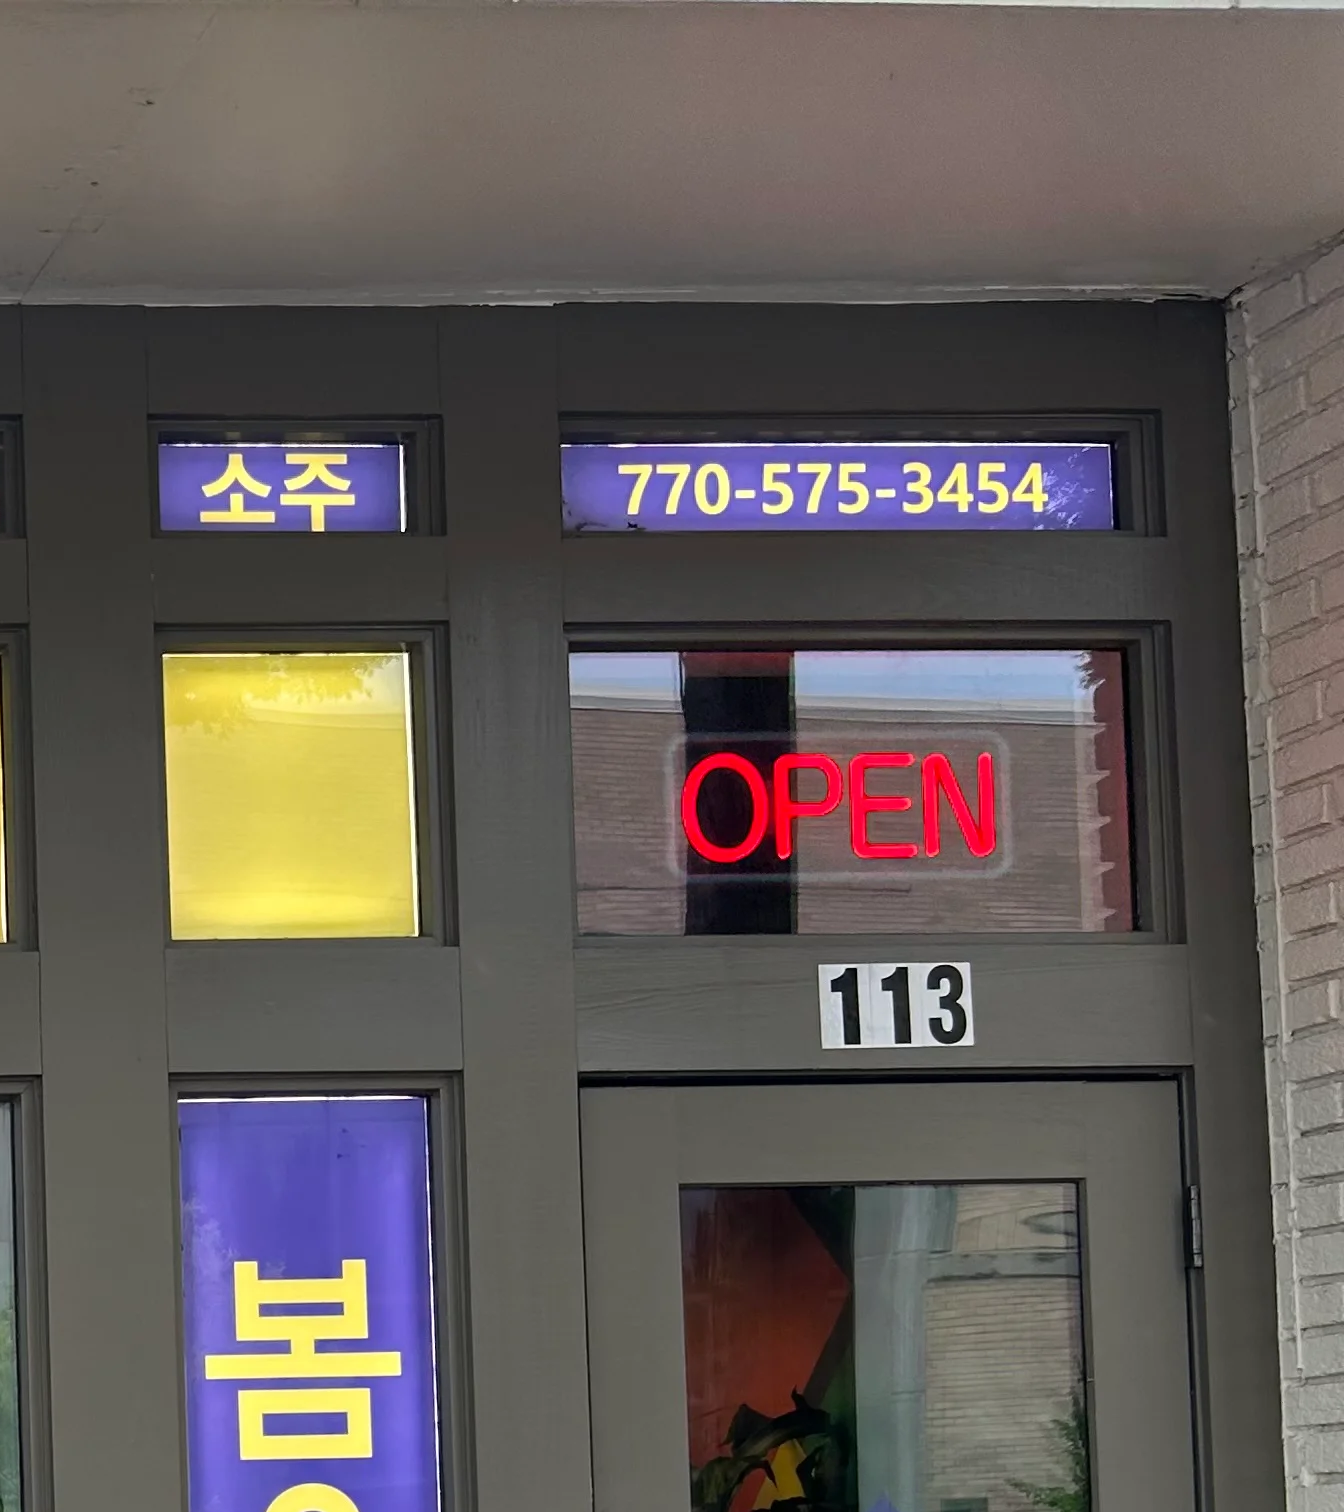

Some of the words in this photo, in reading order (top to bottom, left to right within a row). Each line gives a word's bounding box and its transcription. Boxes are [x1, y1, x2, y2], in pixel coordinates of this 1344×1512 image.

[198, 452, 358, 533] 소주
[617, 461, 1049, 516] 770-575-3454
[680, 751, 997, 863] OPEN
[829, 964, 968, 1046] 113
